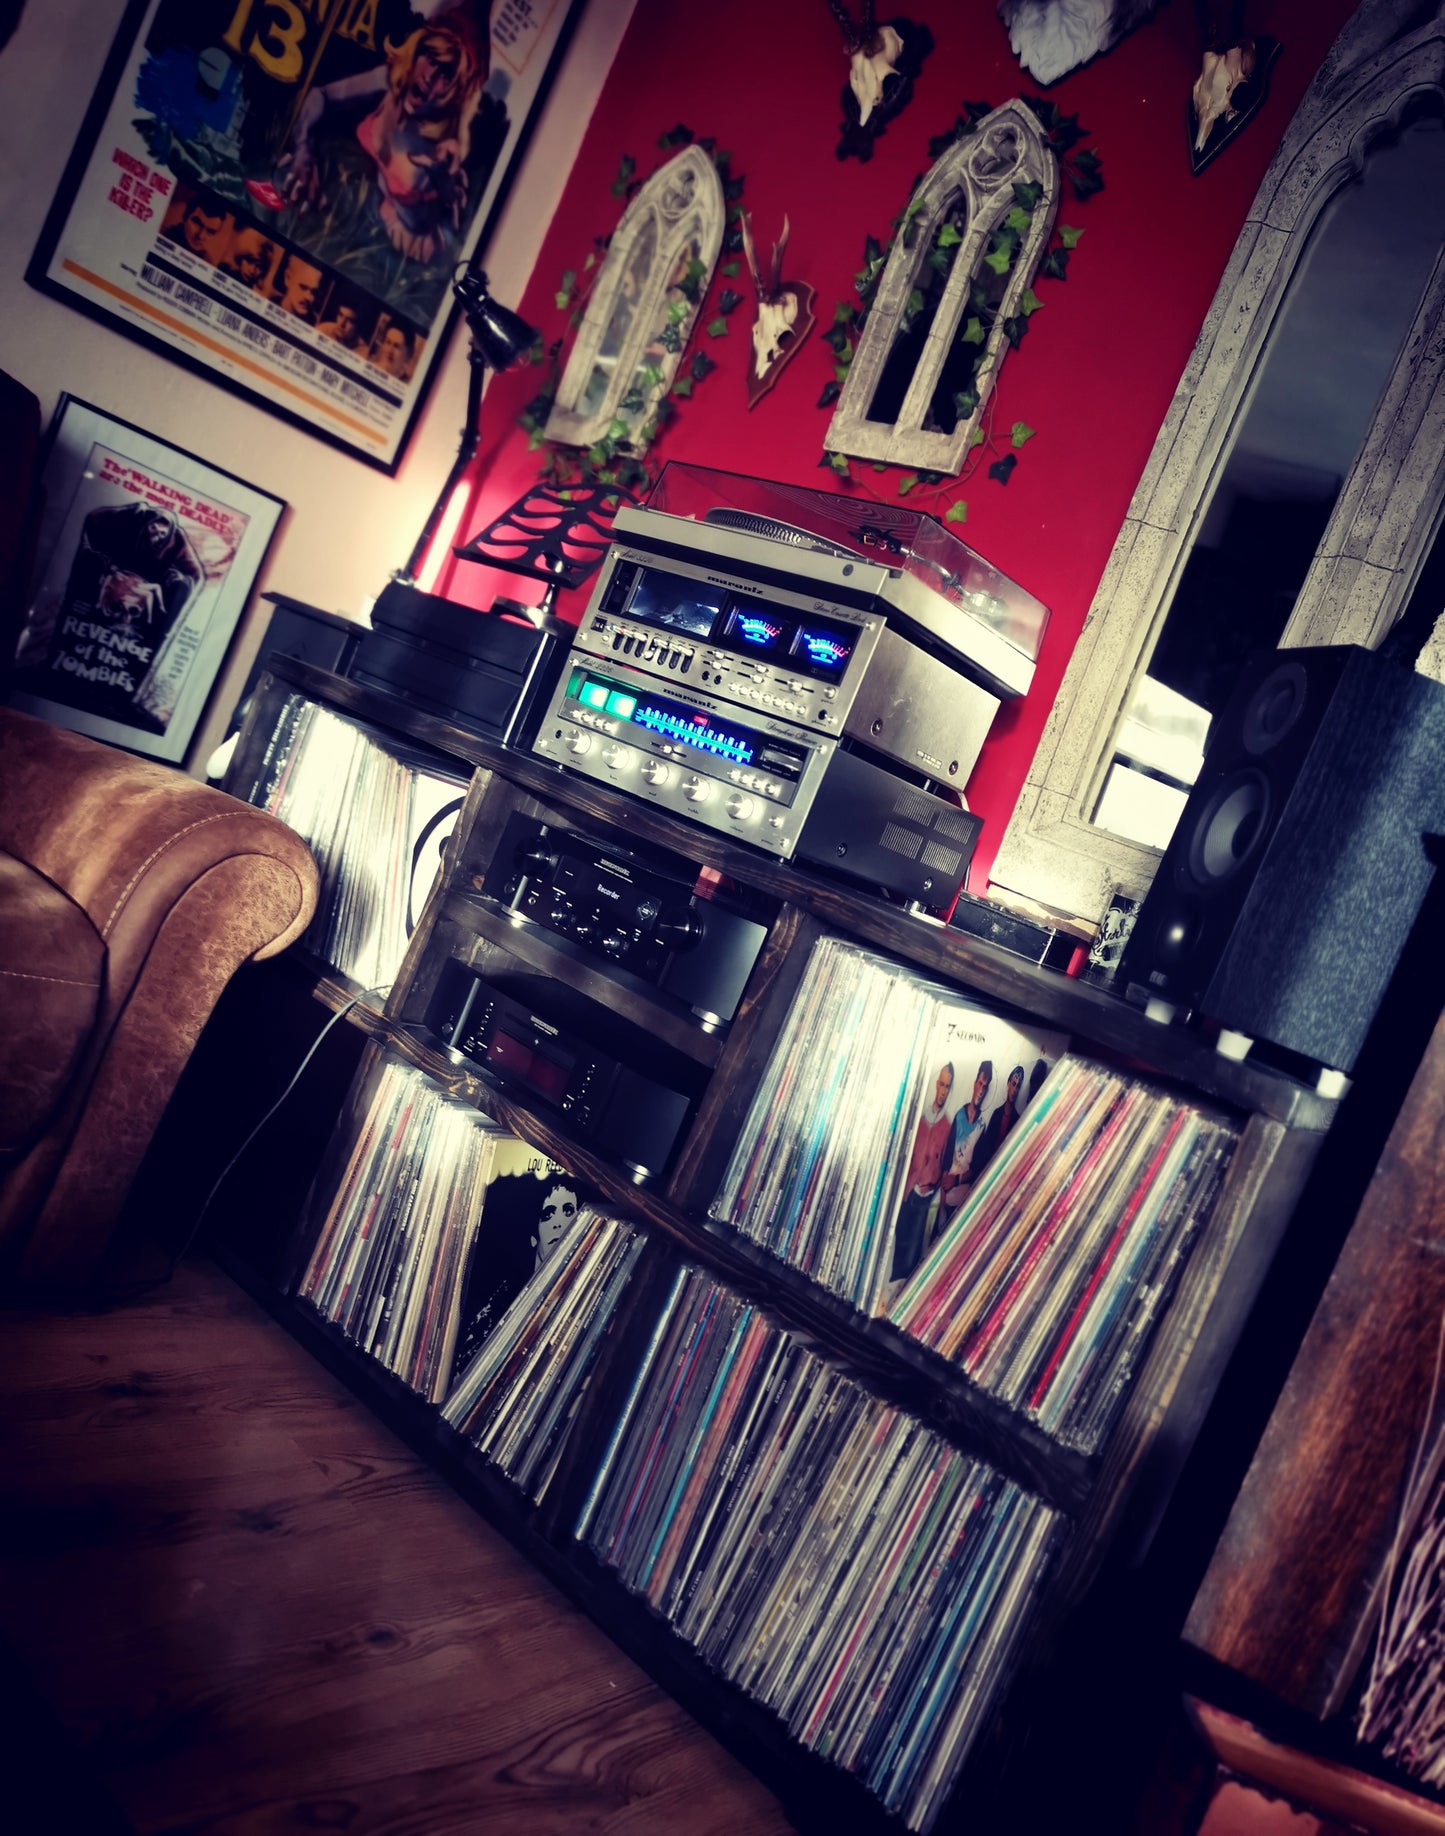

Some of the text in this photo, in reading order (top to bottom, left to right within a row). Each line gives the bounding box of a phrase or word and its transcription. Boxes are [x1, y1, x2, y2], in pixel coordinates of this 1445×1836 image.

[118, 172, 154, 202] IS THE
[150, 171, 174, 197] ONE
[141, 263, 175, 294] WILLIAM
[174, 281, 213, 317] CAMPBELL
[123, 480, 143, 495] the
[145, 492, 175, 510] most
[707, 575, 764, 596] marantz
[62, 615, 153, 663] REVENGE
[74, 643, 128, 668] of the
[51, 650, 136, 692] ZOMBIES
[663, 688, 718, 710] marantz
[597, 883, 620, 900] Recorder
[946, 1023, 986, 1043] 7 SECONDS
[527, 1158, 543, 1172] LOU
